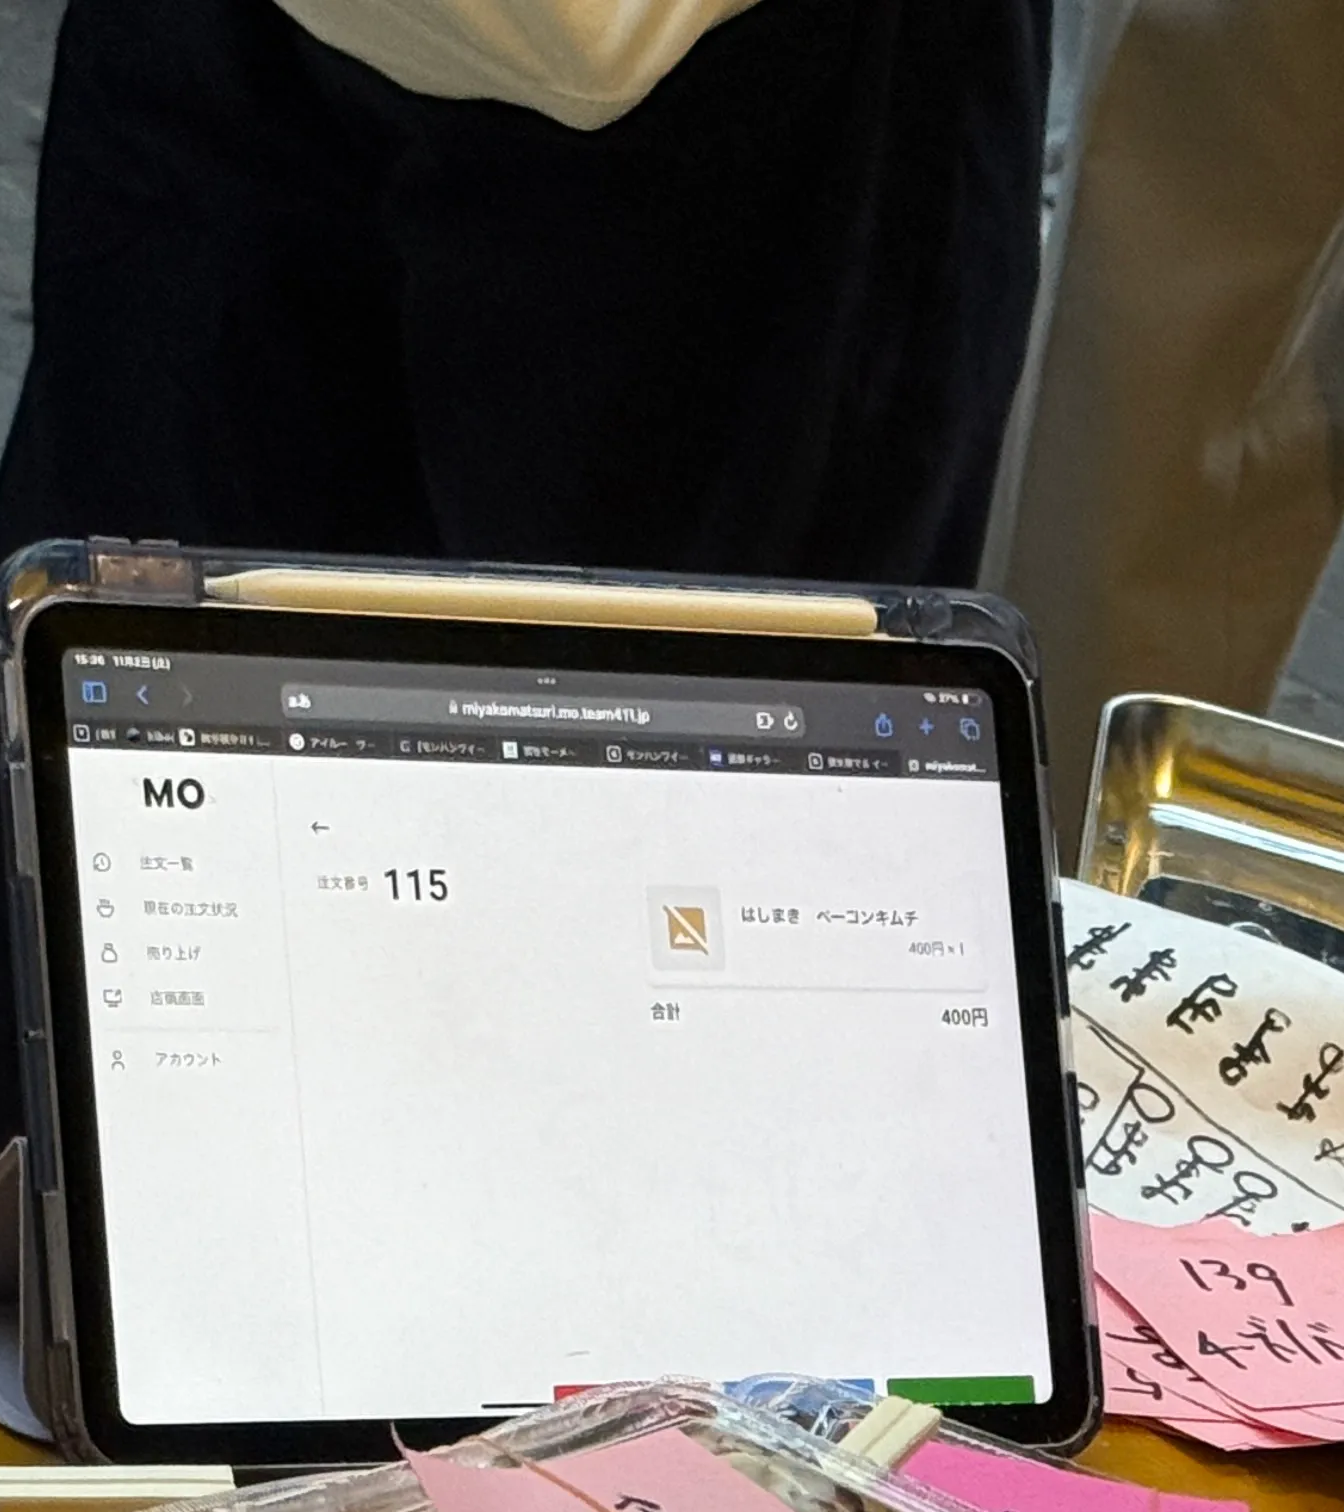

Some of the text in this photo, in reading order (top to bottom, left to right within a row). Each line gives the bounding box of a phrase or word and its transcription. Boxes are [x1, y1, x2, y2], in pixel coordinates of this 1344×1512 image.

[143, 778, 205, 810] MO
[140, 856, 193, 871] 注文一覧
[384, 868, 448, 901] 115
[144, 900, 239, 918] 現在の注文状況
[741, 906, 919, 927] はしまき ベーコンキムチ
[146, 946, 201, 961] 売り上げ
[908, 941, 945, 957] 400円
[650, 1002, 681, 1021] 合計
[941, 1007, 989, 1027] 400円
[155, 1052, 223, 1068] アカウント
[1180, 1258, 1294, 1306] 139
